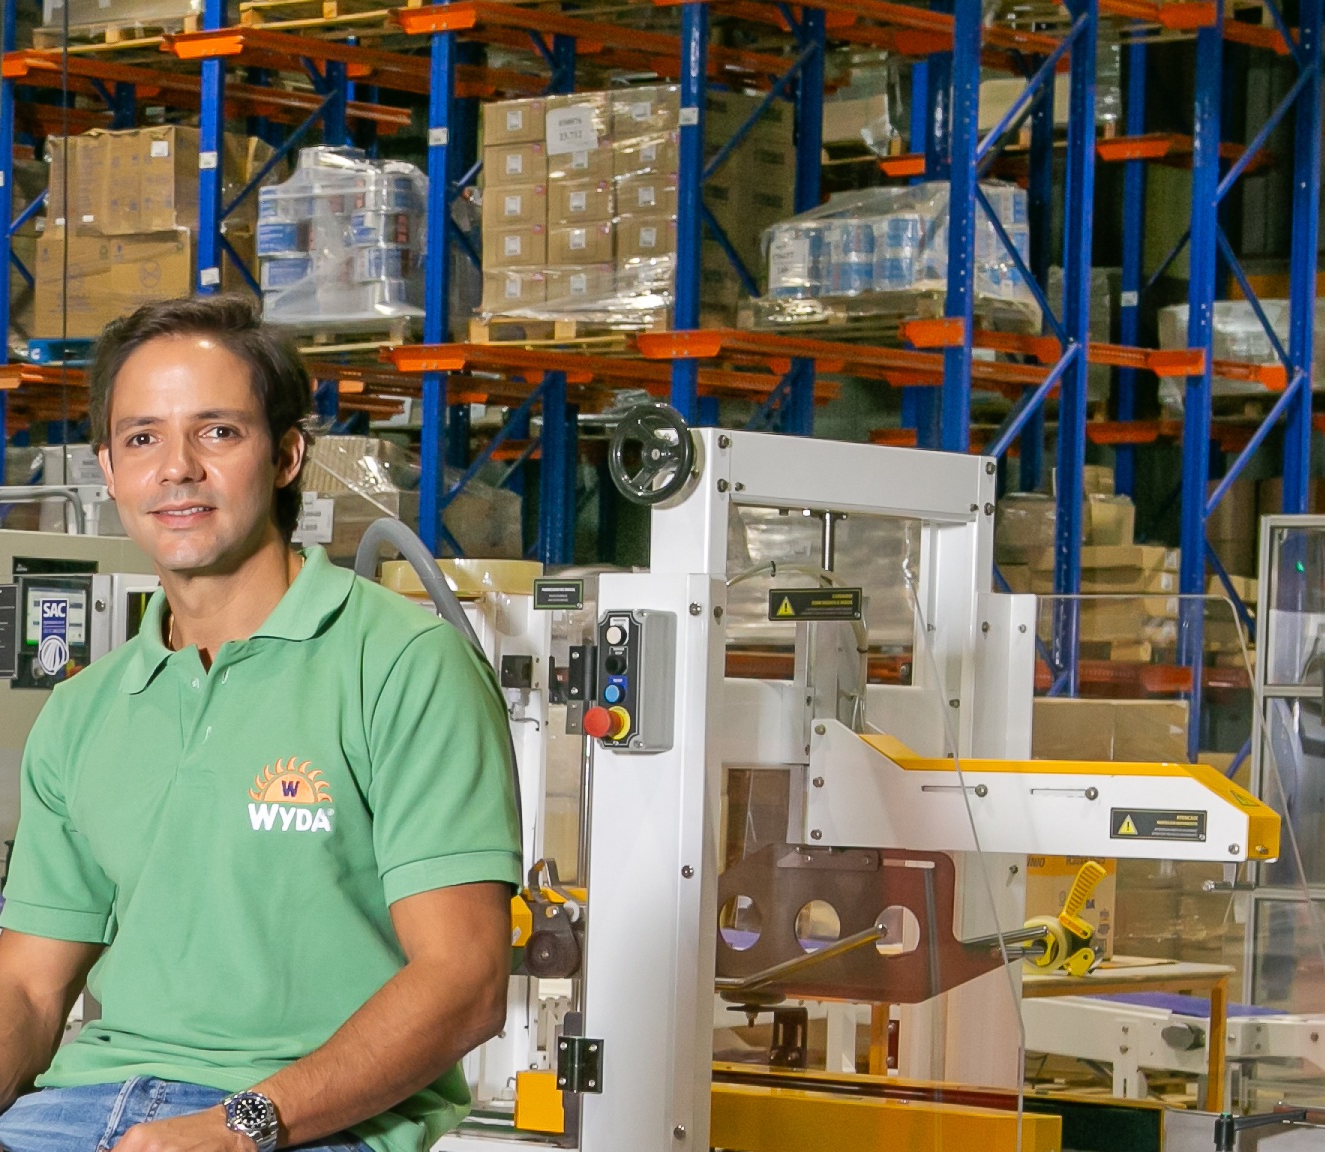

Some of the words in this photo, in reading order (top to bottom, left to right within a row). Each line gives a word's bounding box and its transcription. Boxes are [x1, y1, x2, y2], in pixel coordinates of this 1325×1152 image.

[43, 602, 66, 618] SAC
[281, 780, 300, 797] W
[248, 803, 331, 832] WYDA
